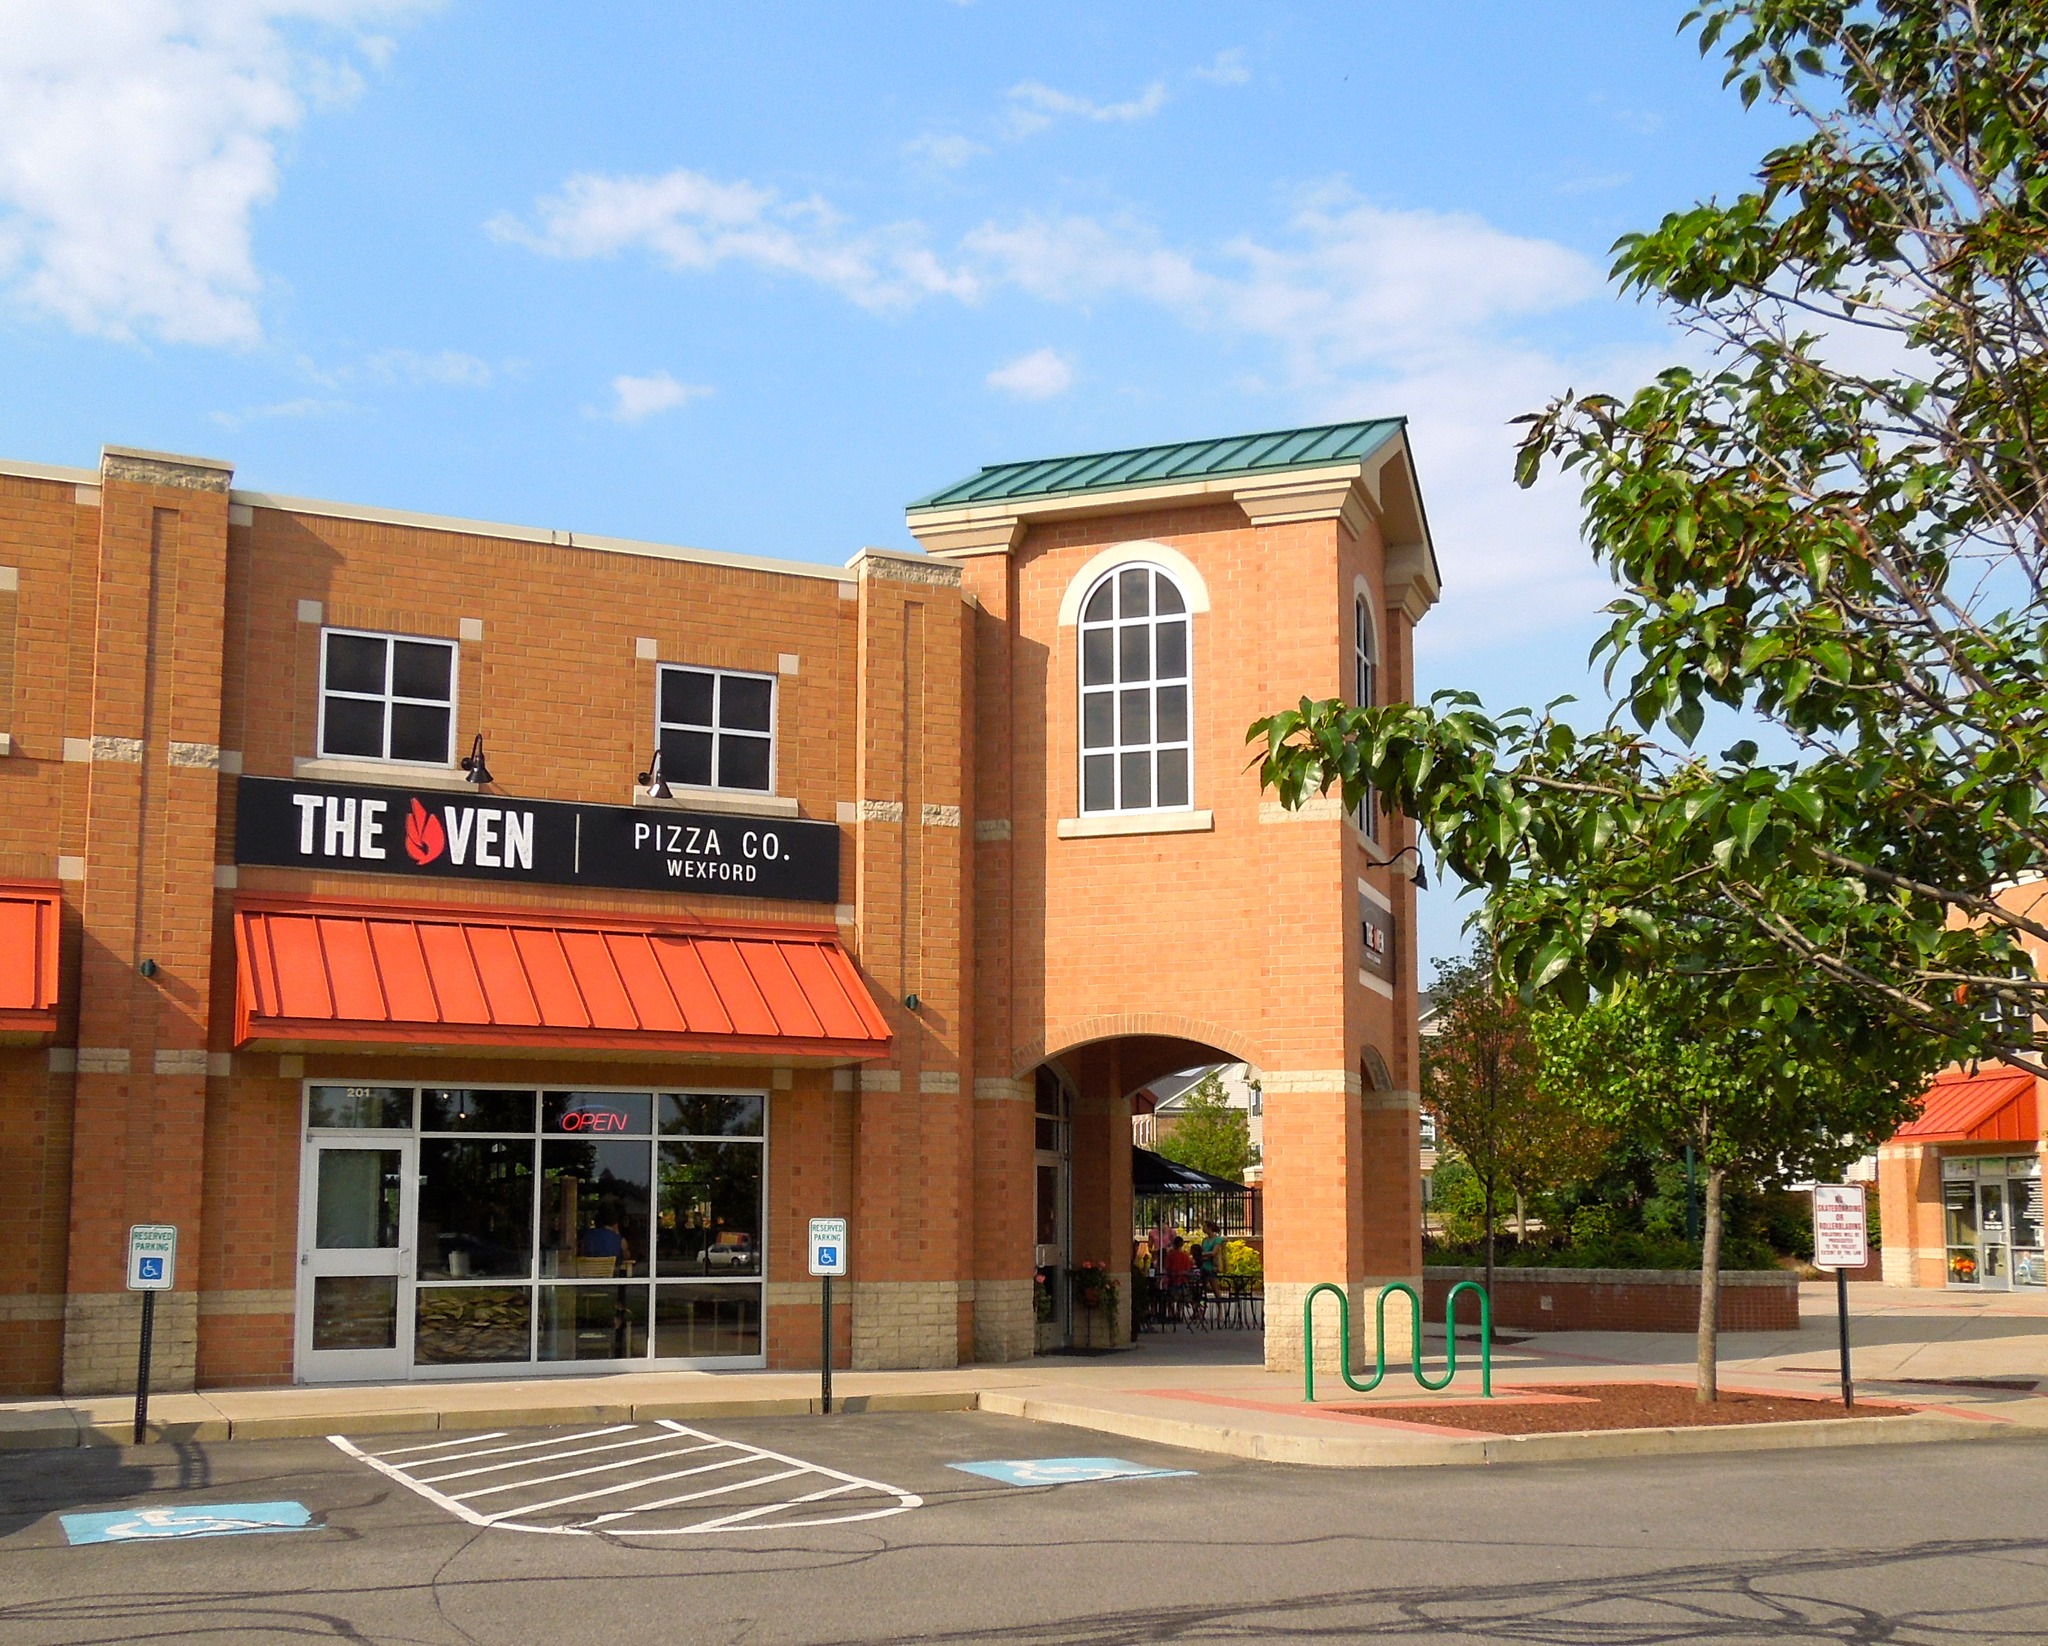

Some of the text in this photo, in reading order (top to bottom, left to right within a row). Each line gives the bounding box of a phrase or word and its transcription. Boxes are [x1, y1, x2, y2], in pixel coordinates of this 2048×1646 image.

[293, 794, 387, 859] THE
[634, 822, 790, 861] PIZZA CO.
[666, 858, 757, 882] WEXFORD
[347, 1088, 370, 1098] 201
[562, 1112, 628, 1131] OPEN
[812, 1224, 843, 1232] RESERVED
[133, 1232, 173, 1240] RESERVED
[814, 1234, 841, 1242] PARKING
[135, 1243, 169, 1251] PARKING
